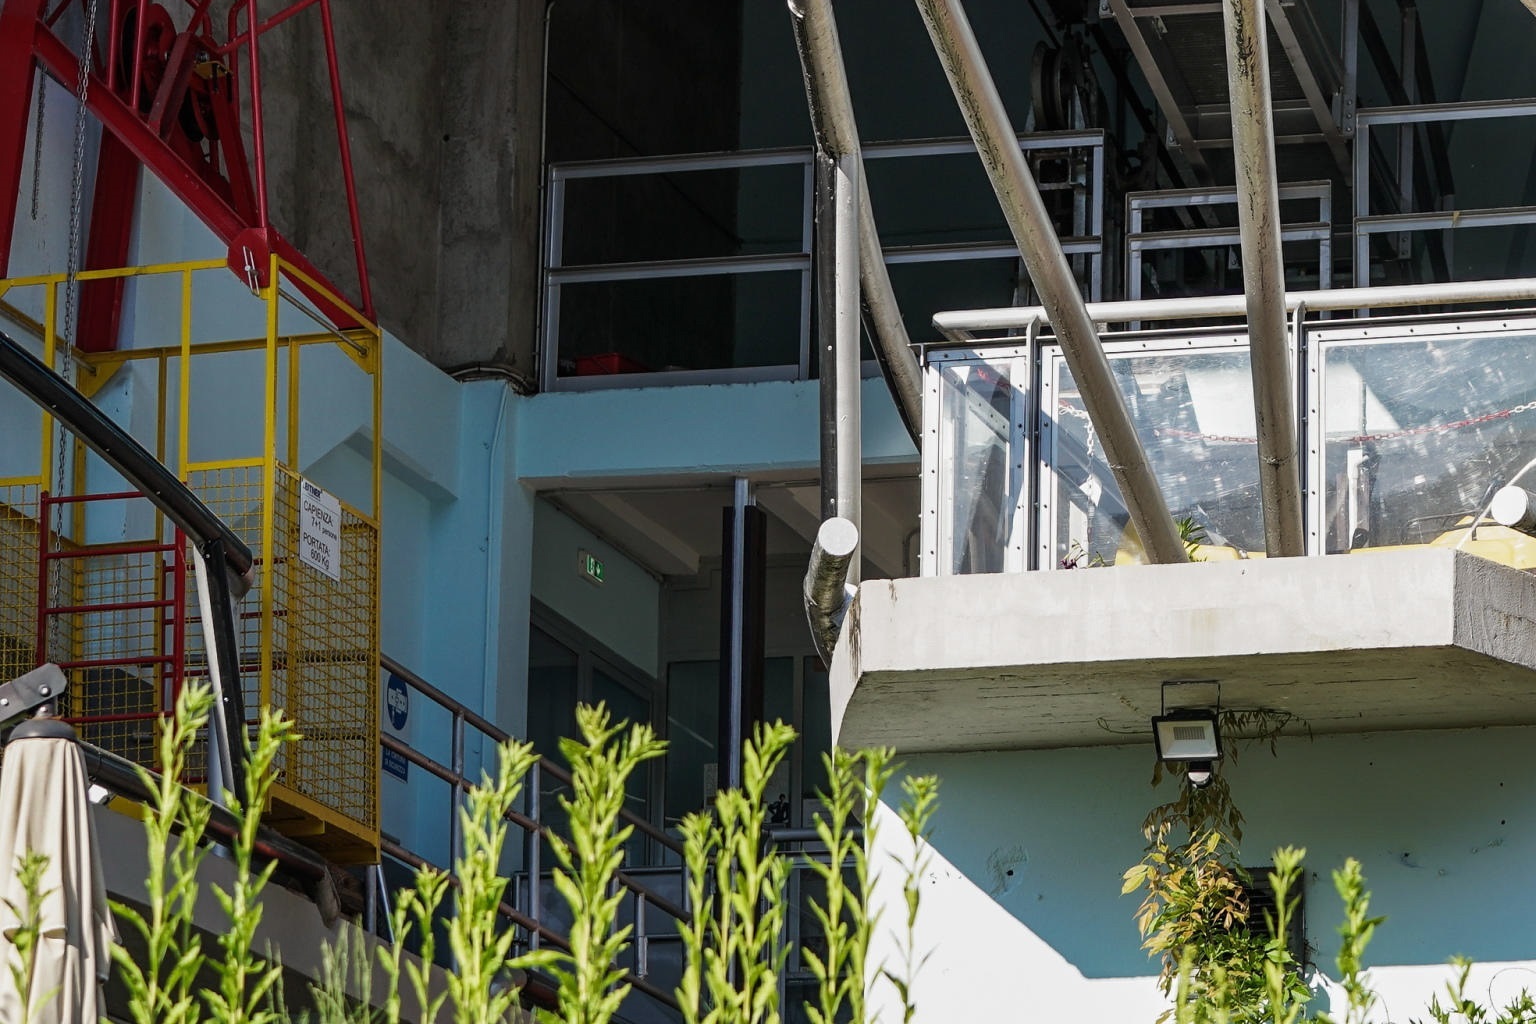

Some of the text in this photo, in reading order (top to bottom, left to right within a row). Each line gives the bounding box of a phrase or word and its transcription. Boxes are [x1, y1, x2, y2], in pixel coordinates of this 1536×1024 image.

[311, 516, 321, 530] 7+1
[303, 532, 331, 557] PORTATA:
[311, 548, 320, 563] 600
